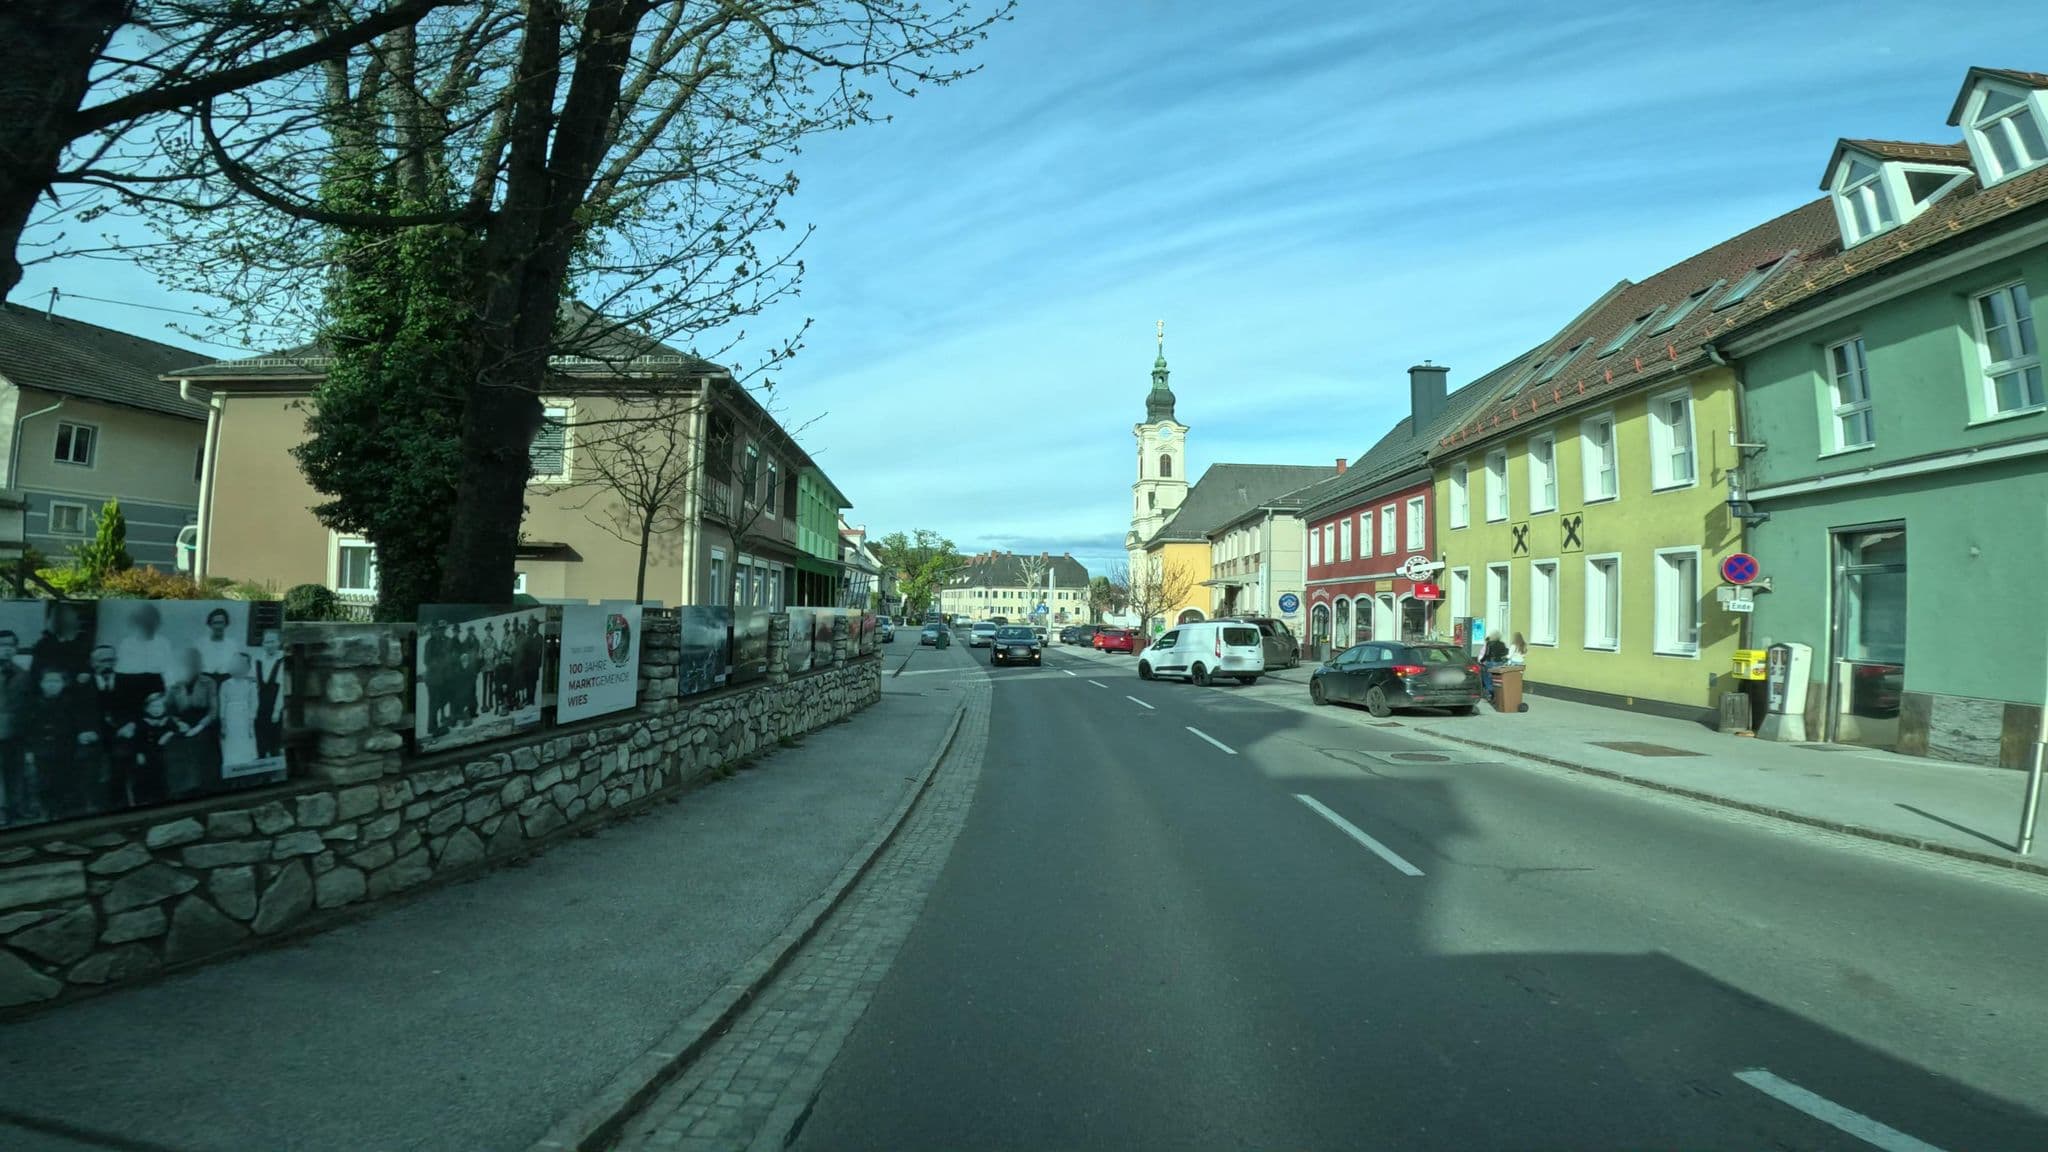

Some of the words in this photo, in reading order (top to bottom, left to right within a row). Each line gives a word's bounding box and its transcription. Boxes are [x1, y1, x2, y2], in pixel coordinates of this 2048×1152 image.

[569, 663, 583, 675] 100
[584, 659, 608, 673] JAHRE
[568, 694, 588, 708] WIES
